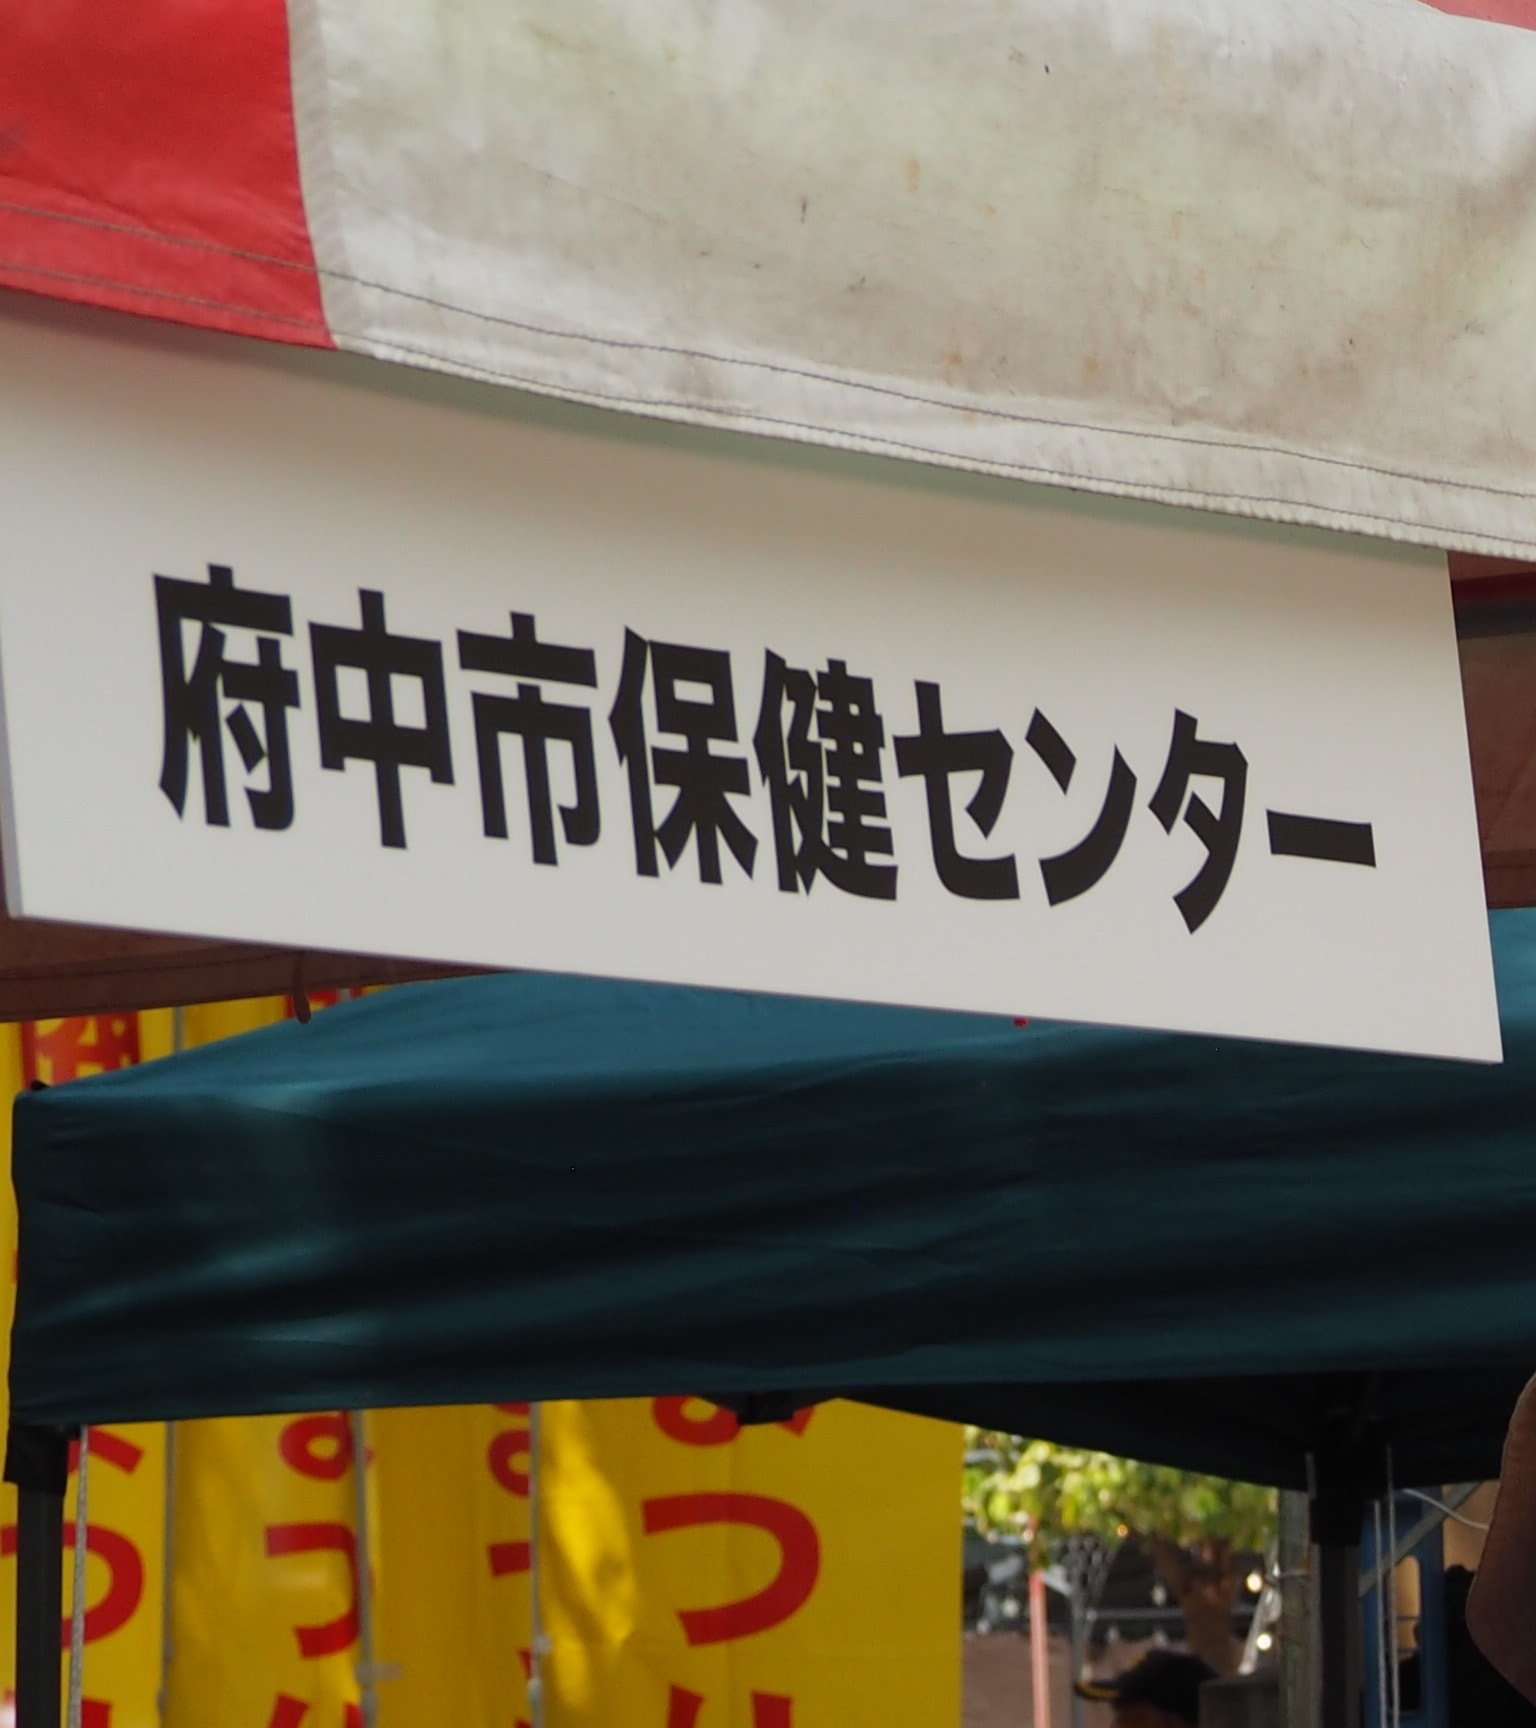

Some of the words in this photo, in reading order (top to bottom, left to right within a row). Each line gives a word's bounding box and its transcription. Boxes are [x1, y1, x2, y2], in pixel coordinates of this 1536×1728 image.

[152, 562, 1377, 935] 府中市保健センター
